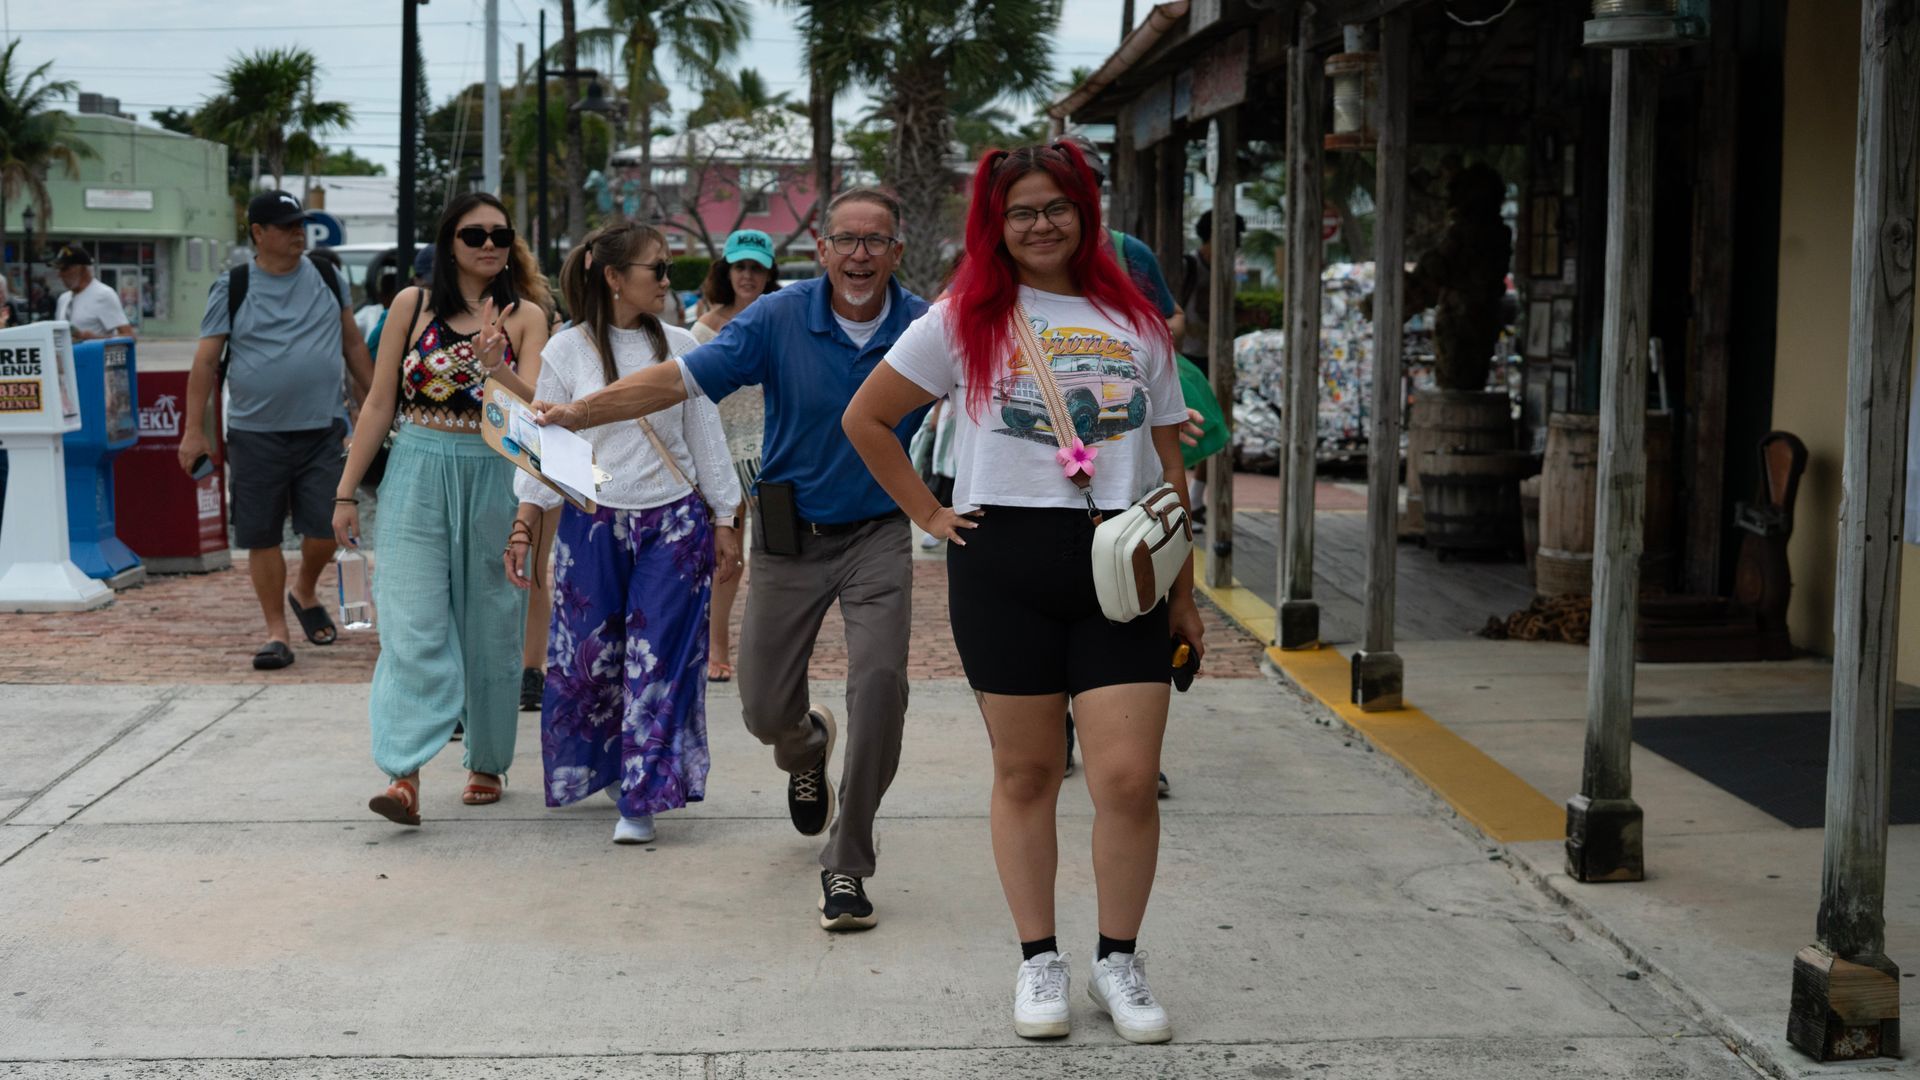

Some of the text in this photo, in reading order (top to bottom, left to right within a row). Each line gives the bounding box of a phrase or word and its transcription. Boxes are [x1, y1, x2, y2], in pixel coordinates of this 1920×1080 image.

[305, 223, 330, 249] P
[0, 348, 41, 364] REE
[0, 365, 42, 376] ENUS
[139, 411, 181, 434] EKLY
